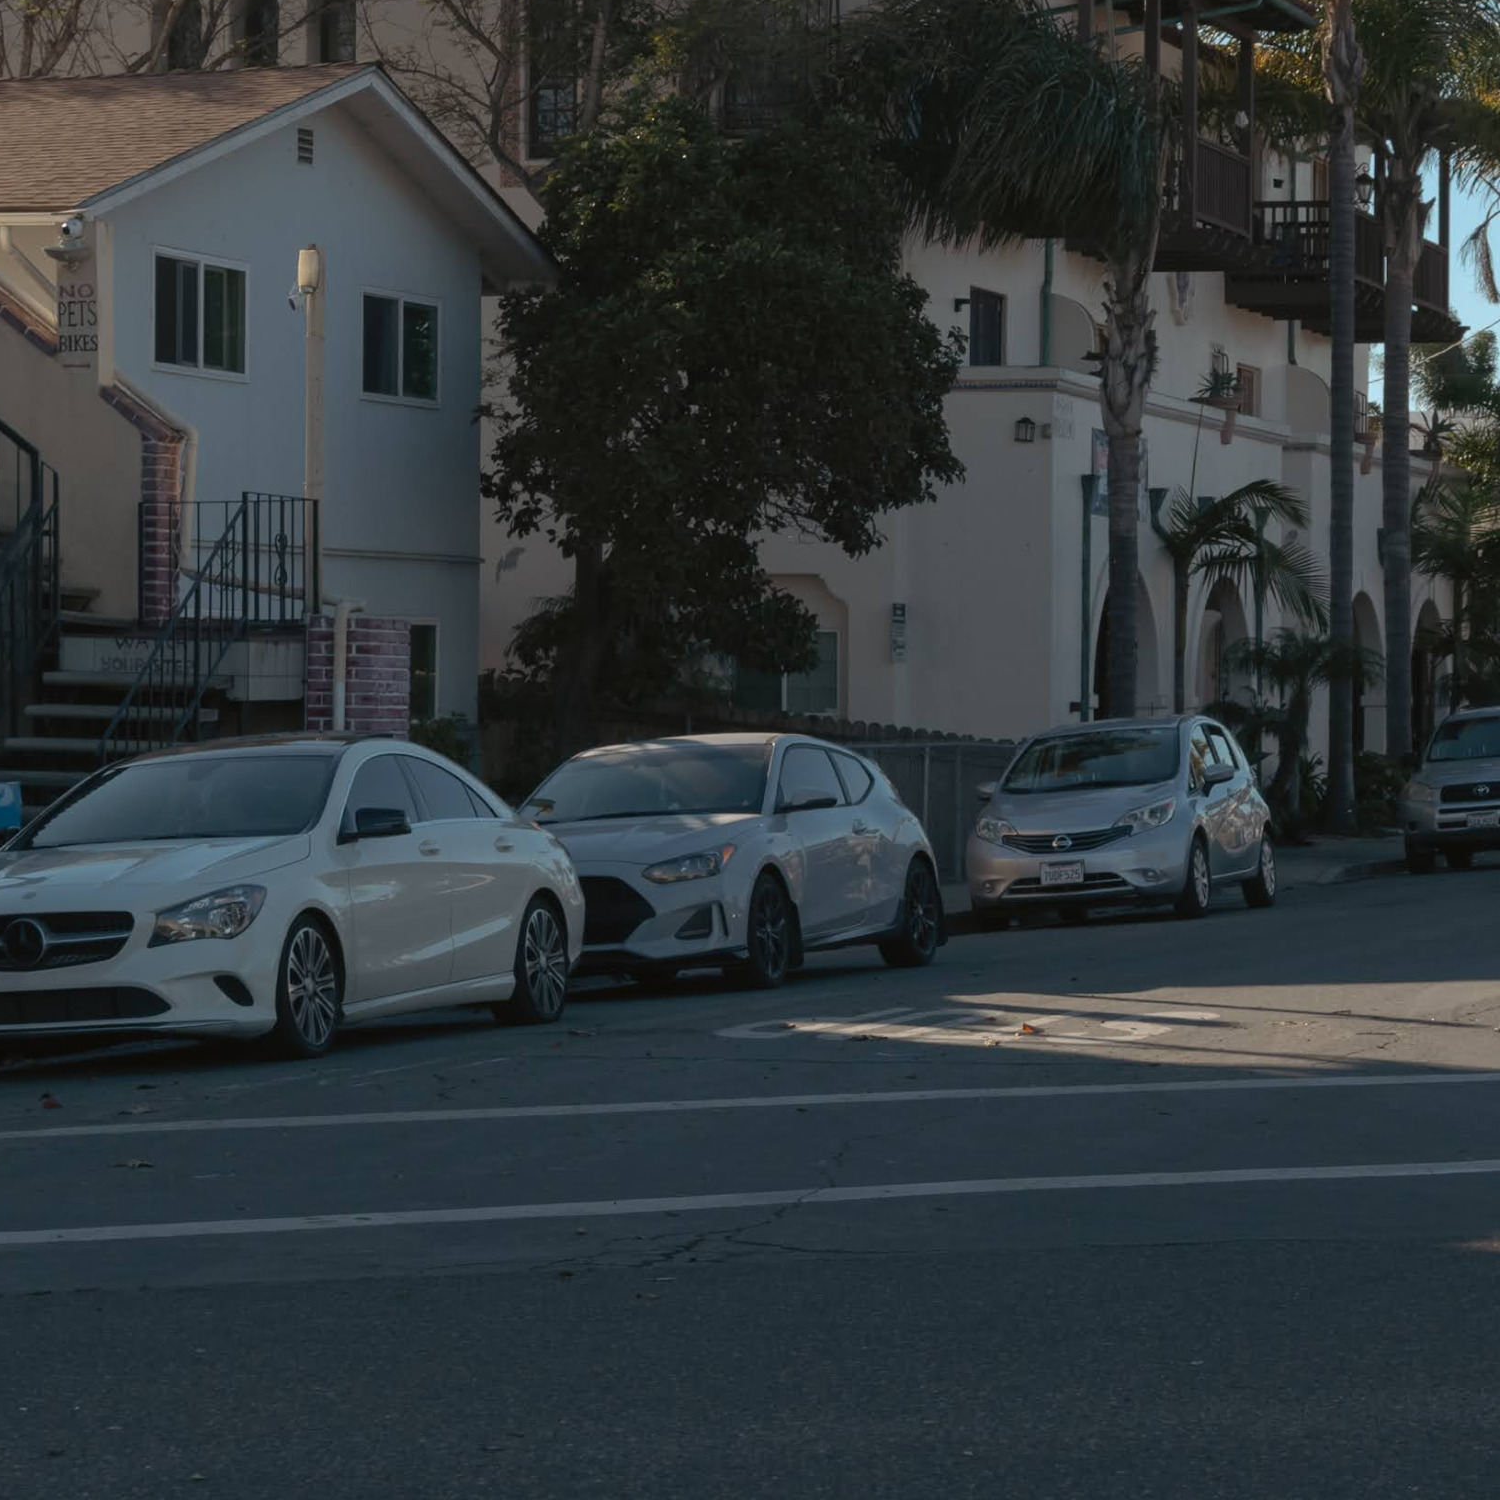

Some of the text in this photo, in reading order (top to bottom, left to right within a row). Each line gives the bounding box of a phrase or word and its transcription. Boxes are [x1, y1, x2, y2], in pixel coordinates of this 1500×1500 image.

[59, 283, 95, 298] NO
[58, 300, 97, 328] PETS
[59, 334, 99, 353] BIKES
